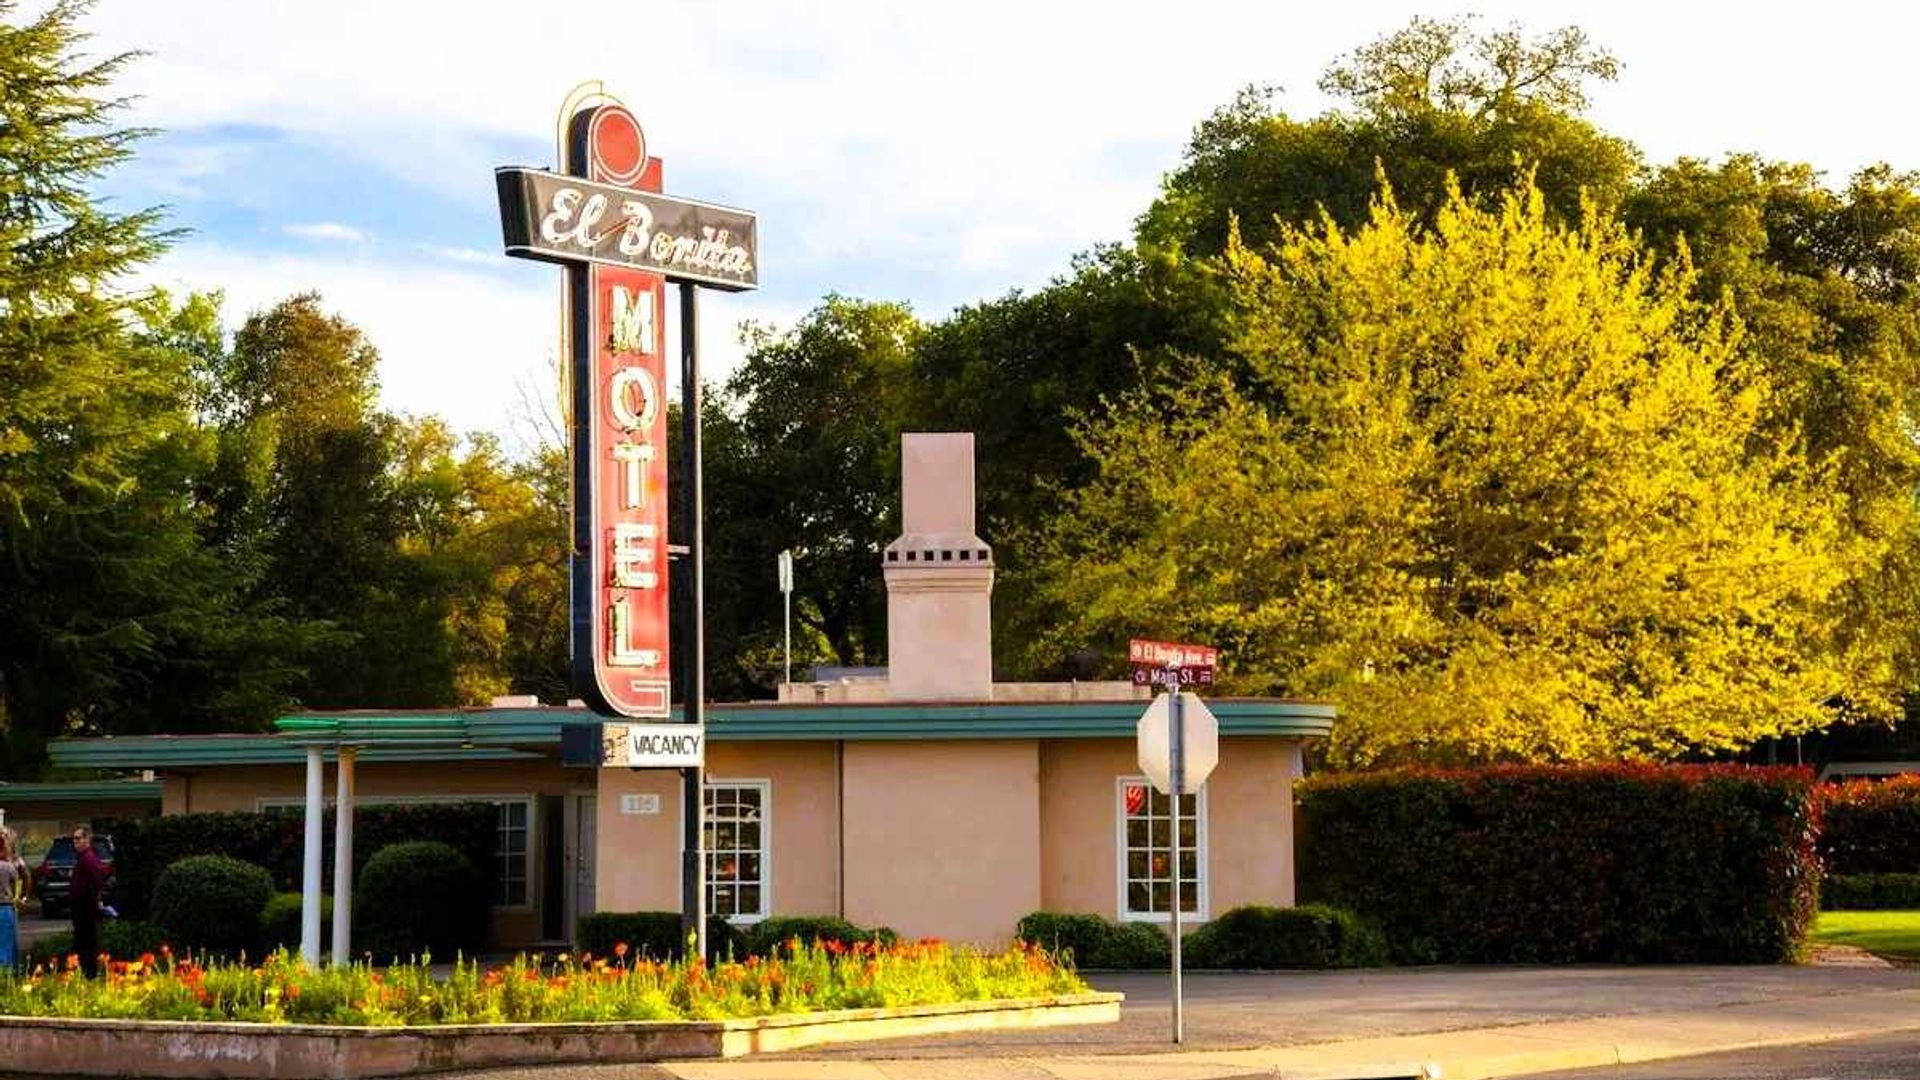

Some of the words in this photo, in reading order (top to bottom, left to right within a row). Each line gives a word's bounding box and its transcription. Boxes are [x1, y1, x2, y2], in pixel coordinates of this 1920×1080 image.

[542, 188, 607, 247] El
[619, 200, 752, 274] Bonita
[606, 284, 660, 668] MOTEL
[1150, 668, 1178, 684] Main
[1181, 668, 1196, 684] St.
[633, 734, 700, 755] VACANCY
